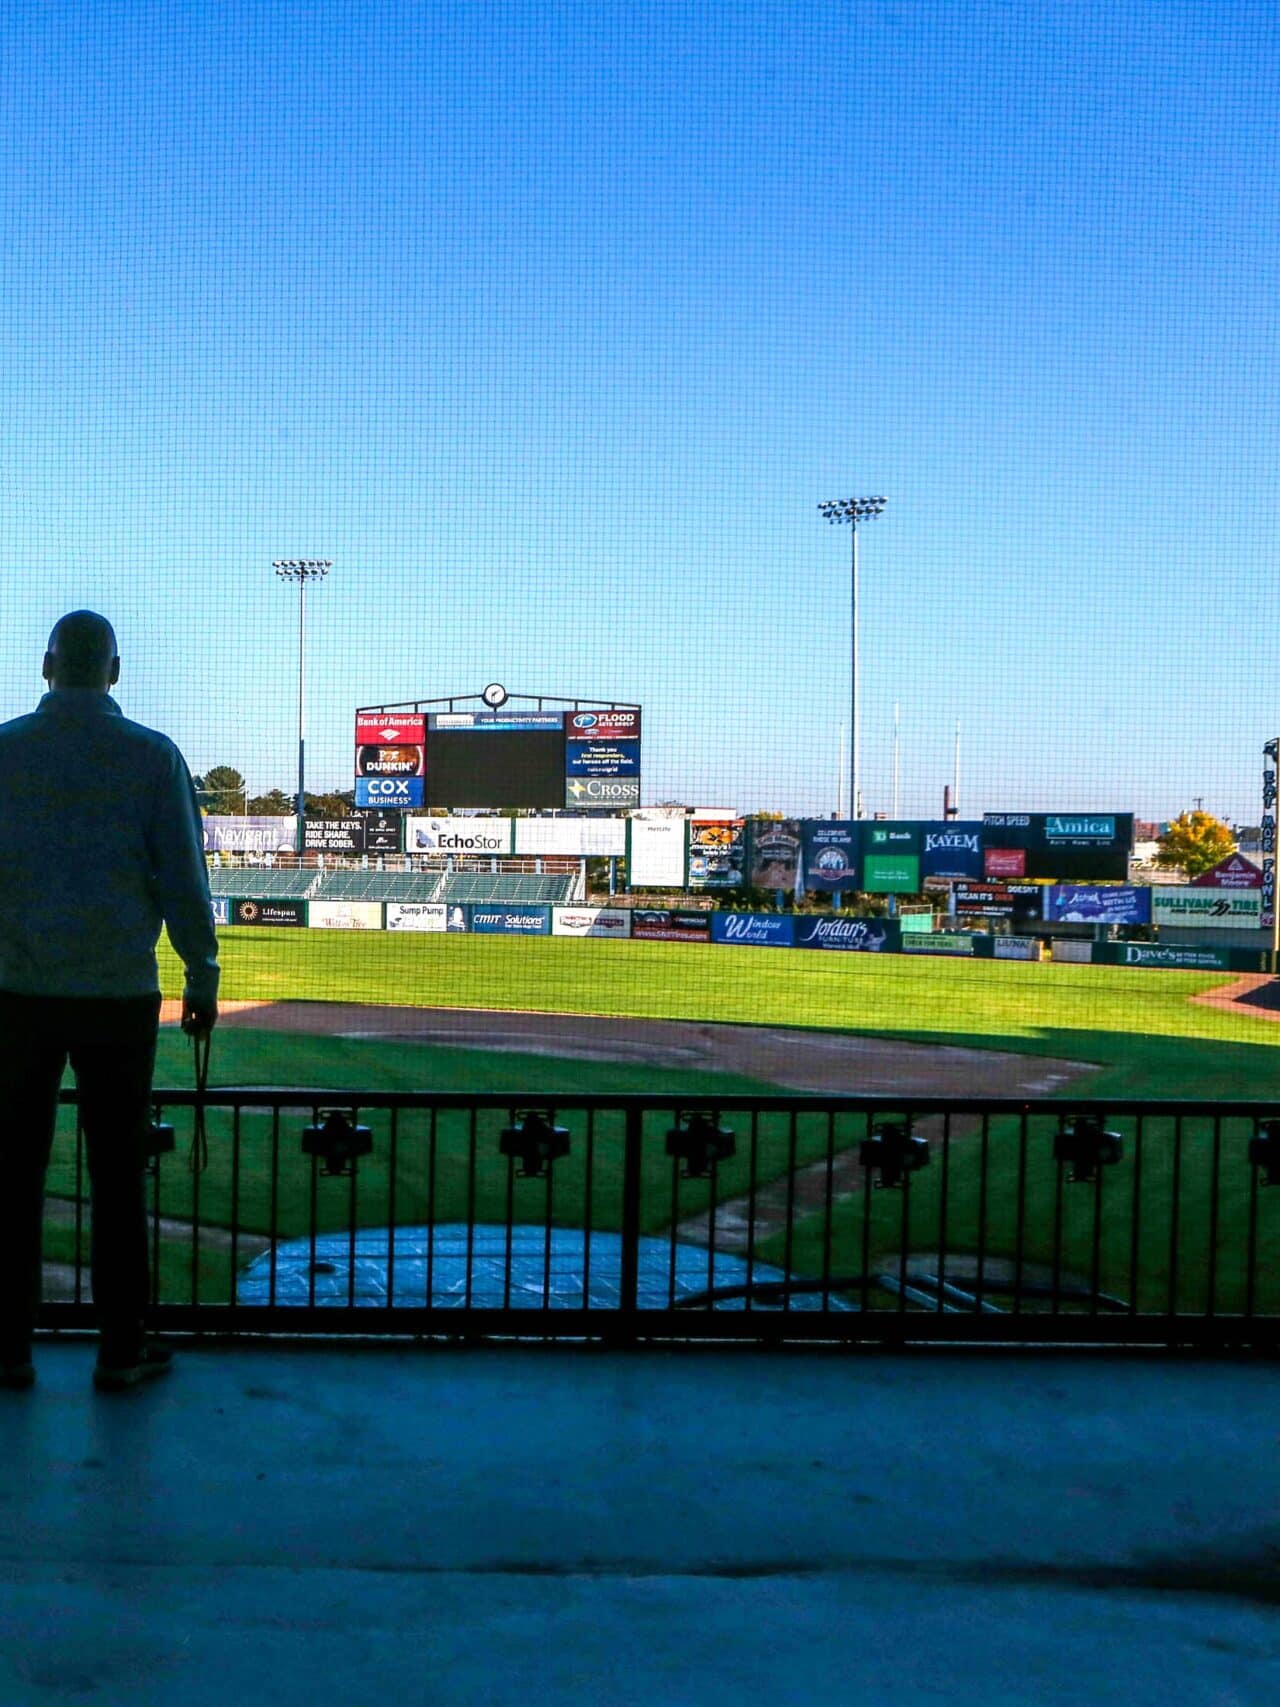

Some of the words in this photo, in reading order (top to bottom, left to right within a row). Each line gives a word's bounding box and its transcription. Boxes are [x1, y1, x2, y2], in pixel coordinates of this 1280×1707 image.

[357, 717, 379, 726] Bank
[380, 717, 388, 726] of
[388, 717, 423, 726] America
[598, 713, 635, 721] FLOOD
[366, 762, 414, 772] DUNKIN'
[368, 780, 409, 795] COX
[305, 821, 324, 830] TAKE
[325, 821, 340, 830] THE
[340, 821, 363, 830] KEYS.
[1006, 816, 1031, 826] SPEED
[1044, 817, 1110, 833] Amica
[214, 826, 277, 845] Navigant
[305, 830, 323, 838] RIDE
[324, 830, 351, 839] SHARE.
[305, 839, 327, 848] DRIVE
[328, 839, 355, 848] SOBER.
[438, 834, 503, 849] EchoStor
[925, 834, 979, 852] KAYEM
[980, 892, 993, 901] IT'S
[1154, 897, 1213, 908] SULLIVAN
[1232, 900, 1259, 910] TIRE
[262, 908, 296, 918] Lifespan
[400, 906, 421, 916] Sump
[422, 906, 443, 915] Pump
[473, 914, 501, 924] CMIT
[505, 914, 545, 925] Solutions
[799, 918, 868, 942] Jordan's
[1125, 947, 1176, 963] Dave's
